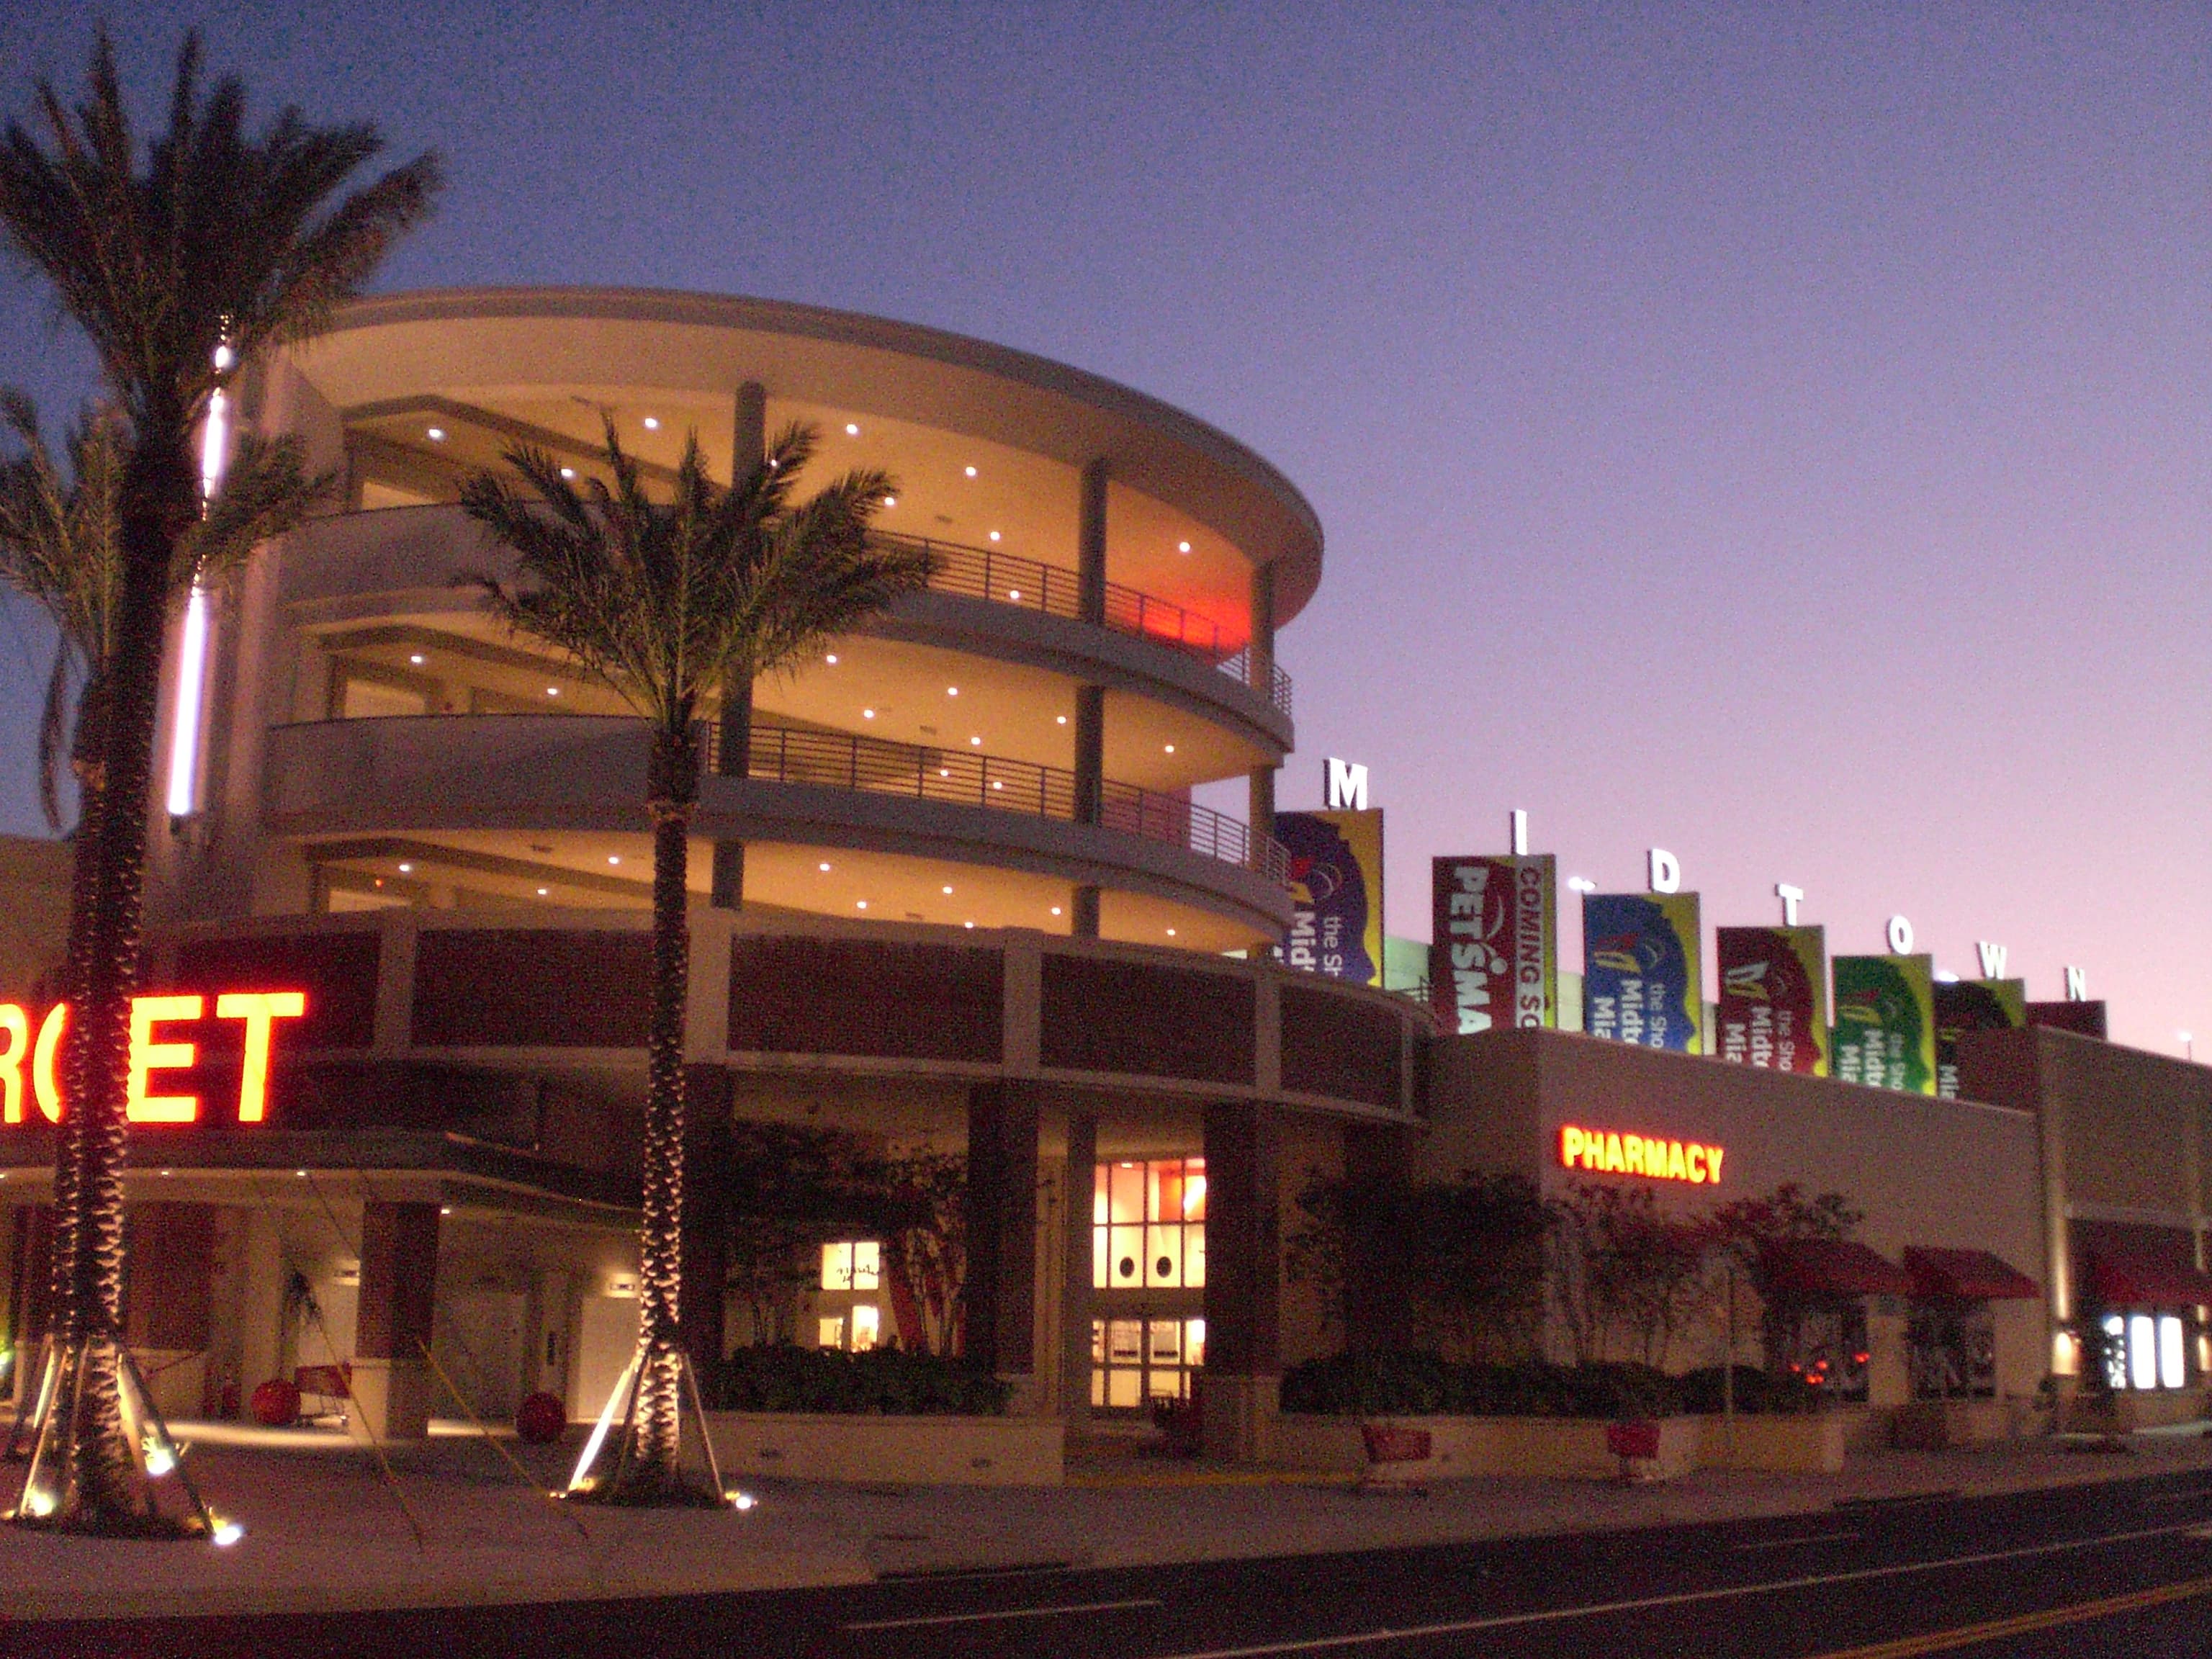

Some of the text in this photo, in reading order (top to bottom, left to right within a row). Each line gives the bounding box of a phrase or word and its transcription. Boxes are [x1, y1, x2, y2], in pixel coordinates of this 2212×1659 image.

[1323, 915, 1344, 948] the
[1520, 866, 1541, 985] COMING
[1561, 1125, 1724, 1184] PHARMACY
